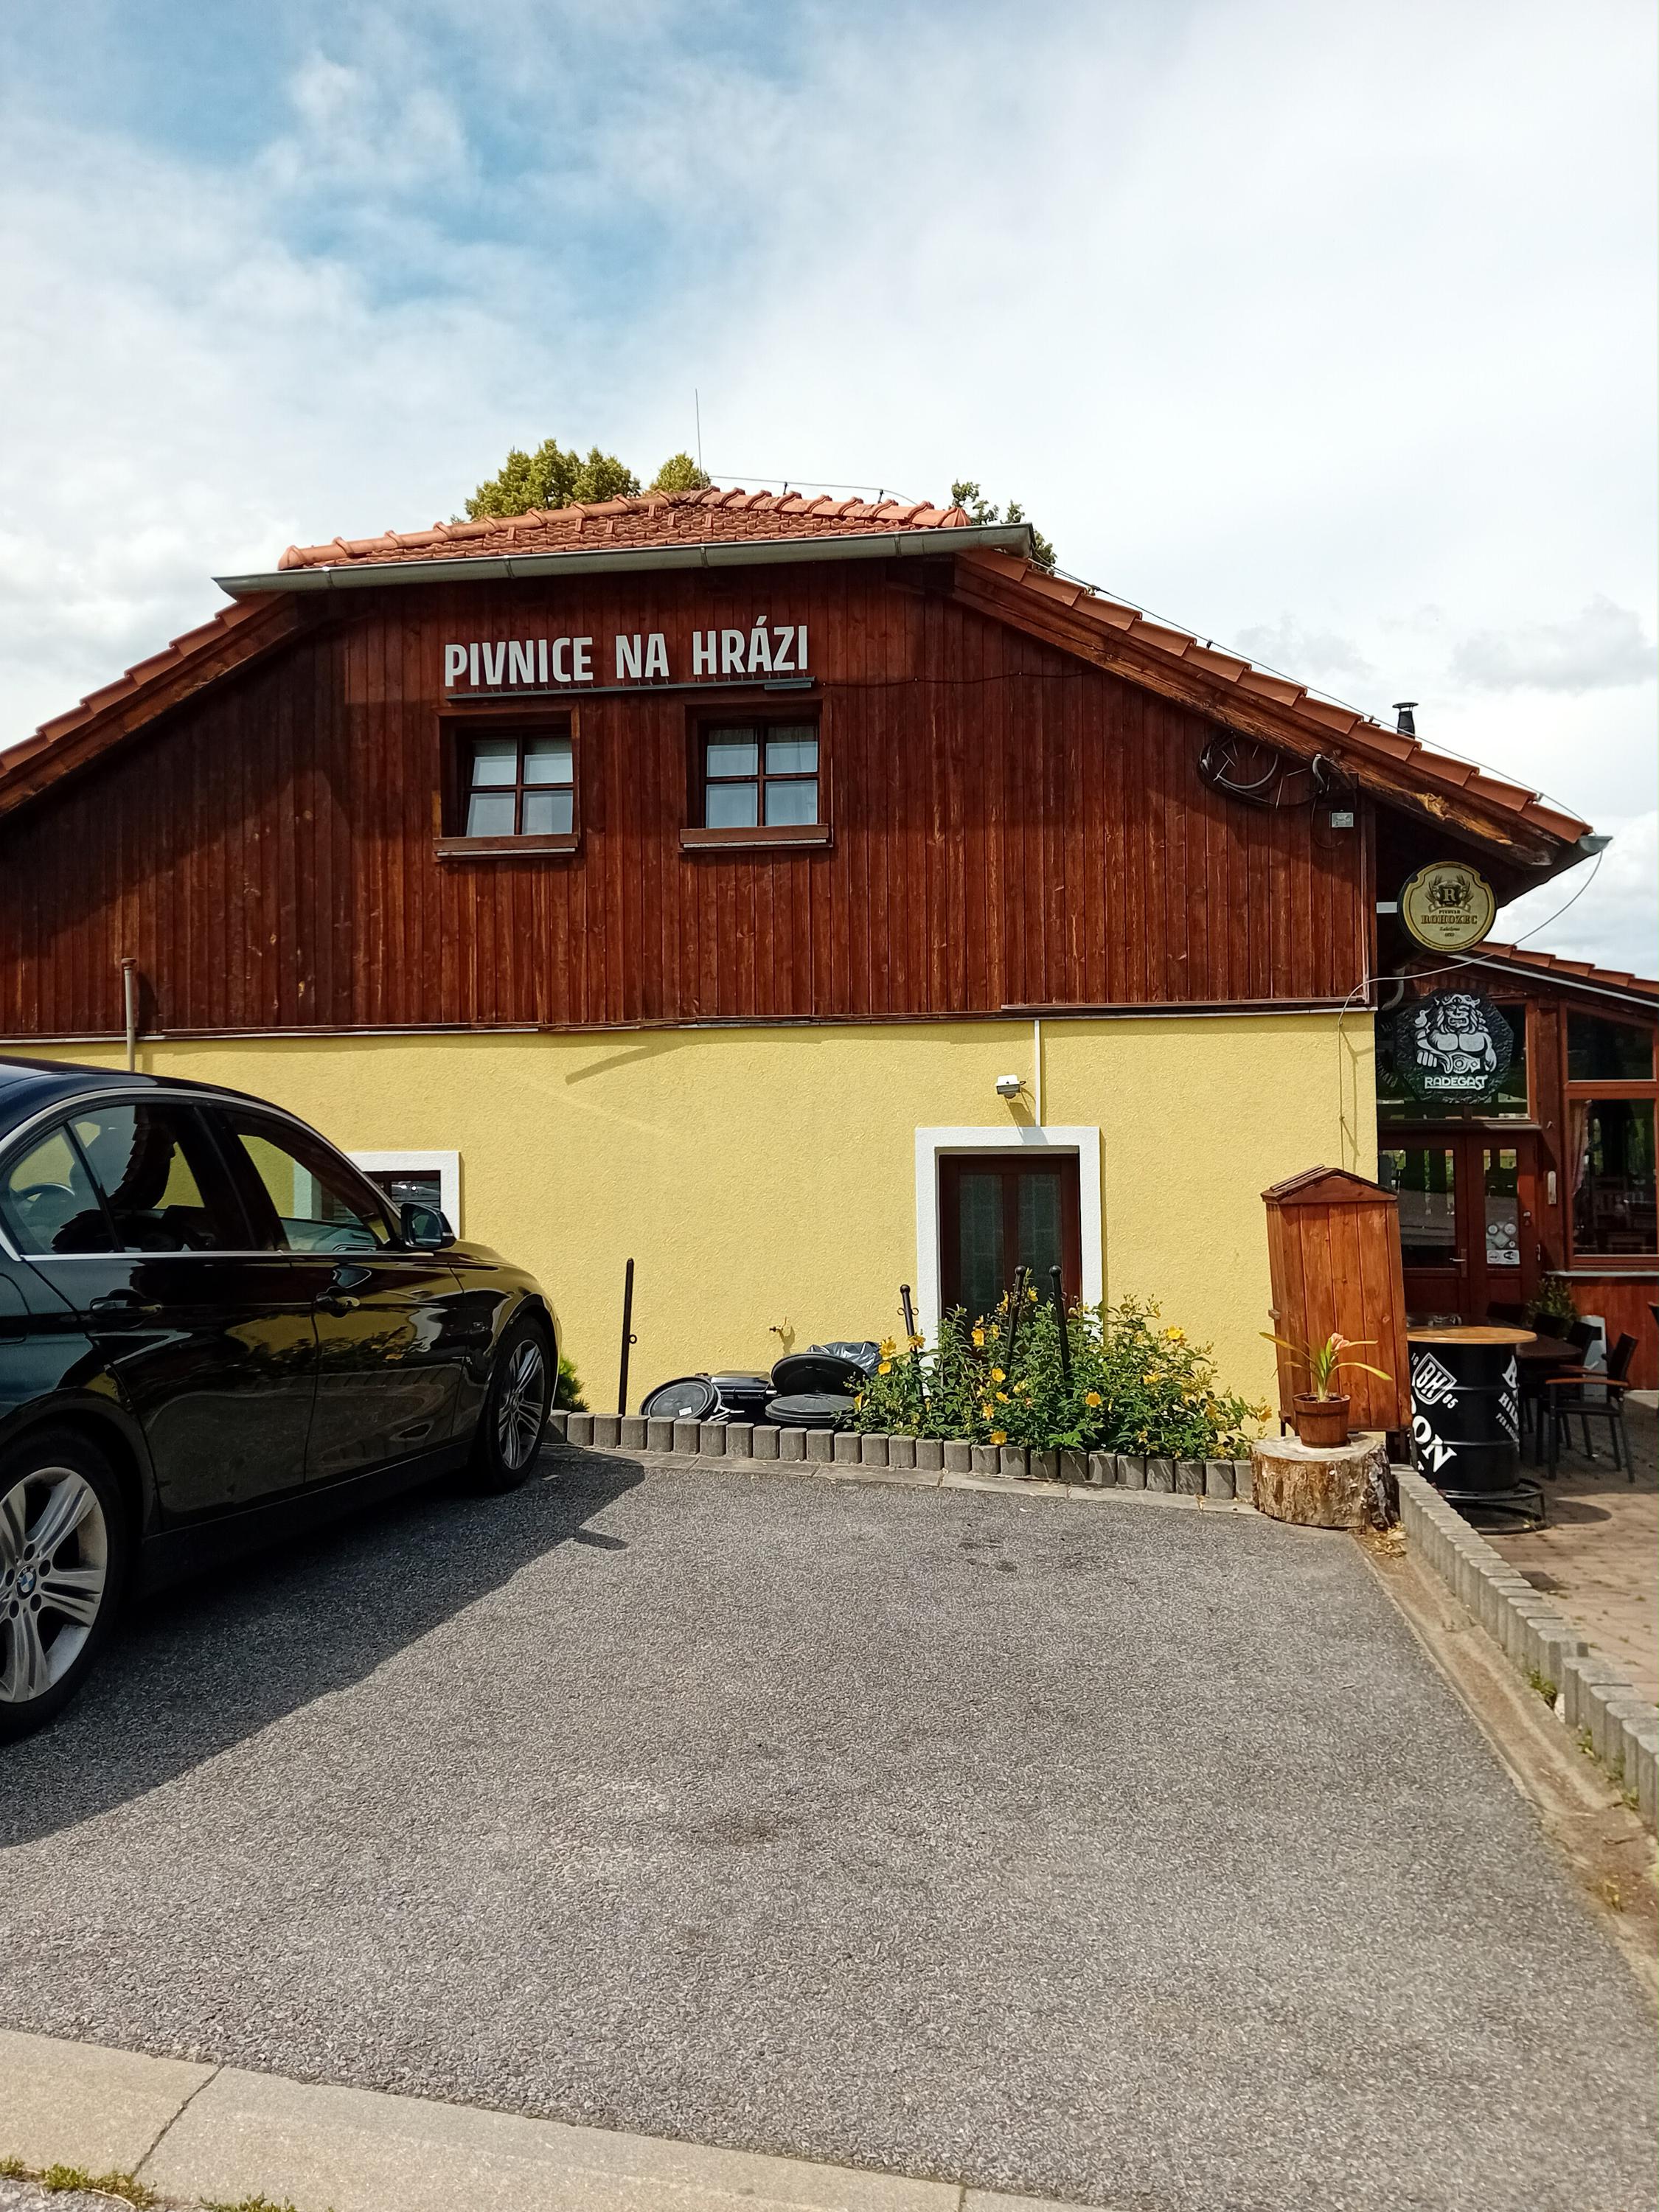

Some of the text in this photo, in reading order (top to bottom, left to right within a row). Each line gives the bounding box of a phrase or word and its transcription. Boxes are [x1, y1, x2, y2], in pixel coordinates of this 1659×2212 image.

[445, 615, 807, 686] PIVNICE NA HRÁZI
[1442, 888, 1456, 902] R
[1425, 1074, 1488, 1091] RADEGAST
[1416, 1361, 1447, 1398] BH
[1442, 1394, 1458, 1409] 85
